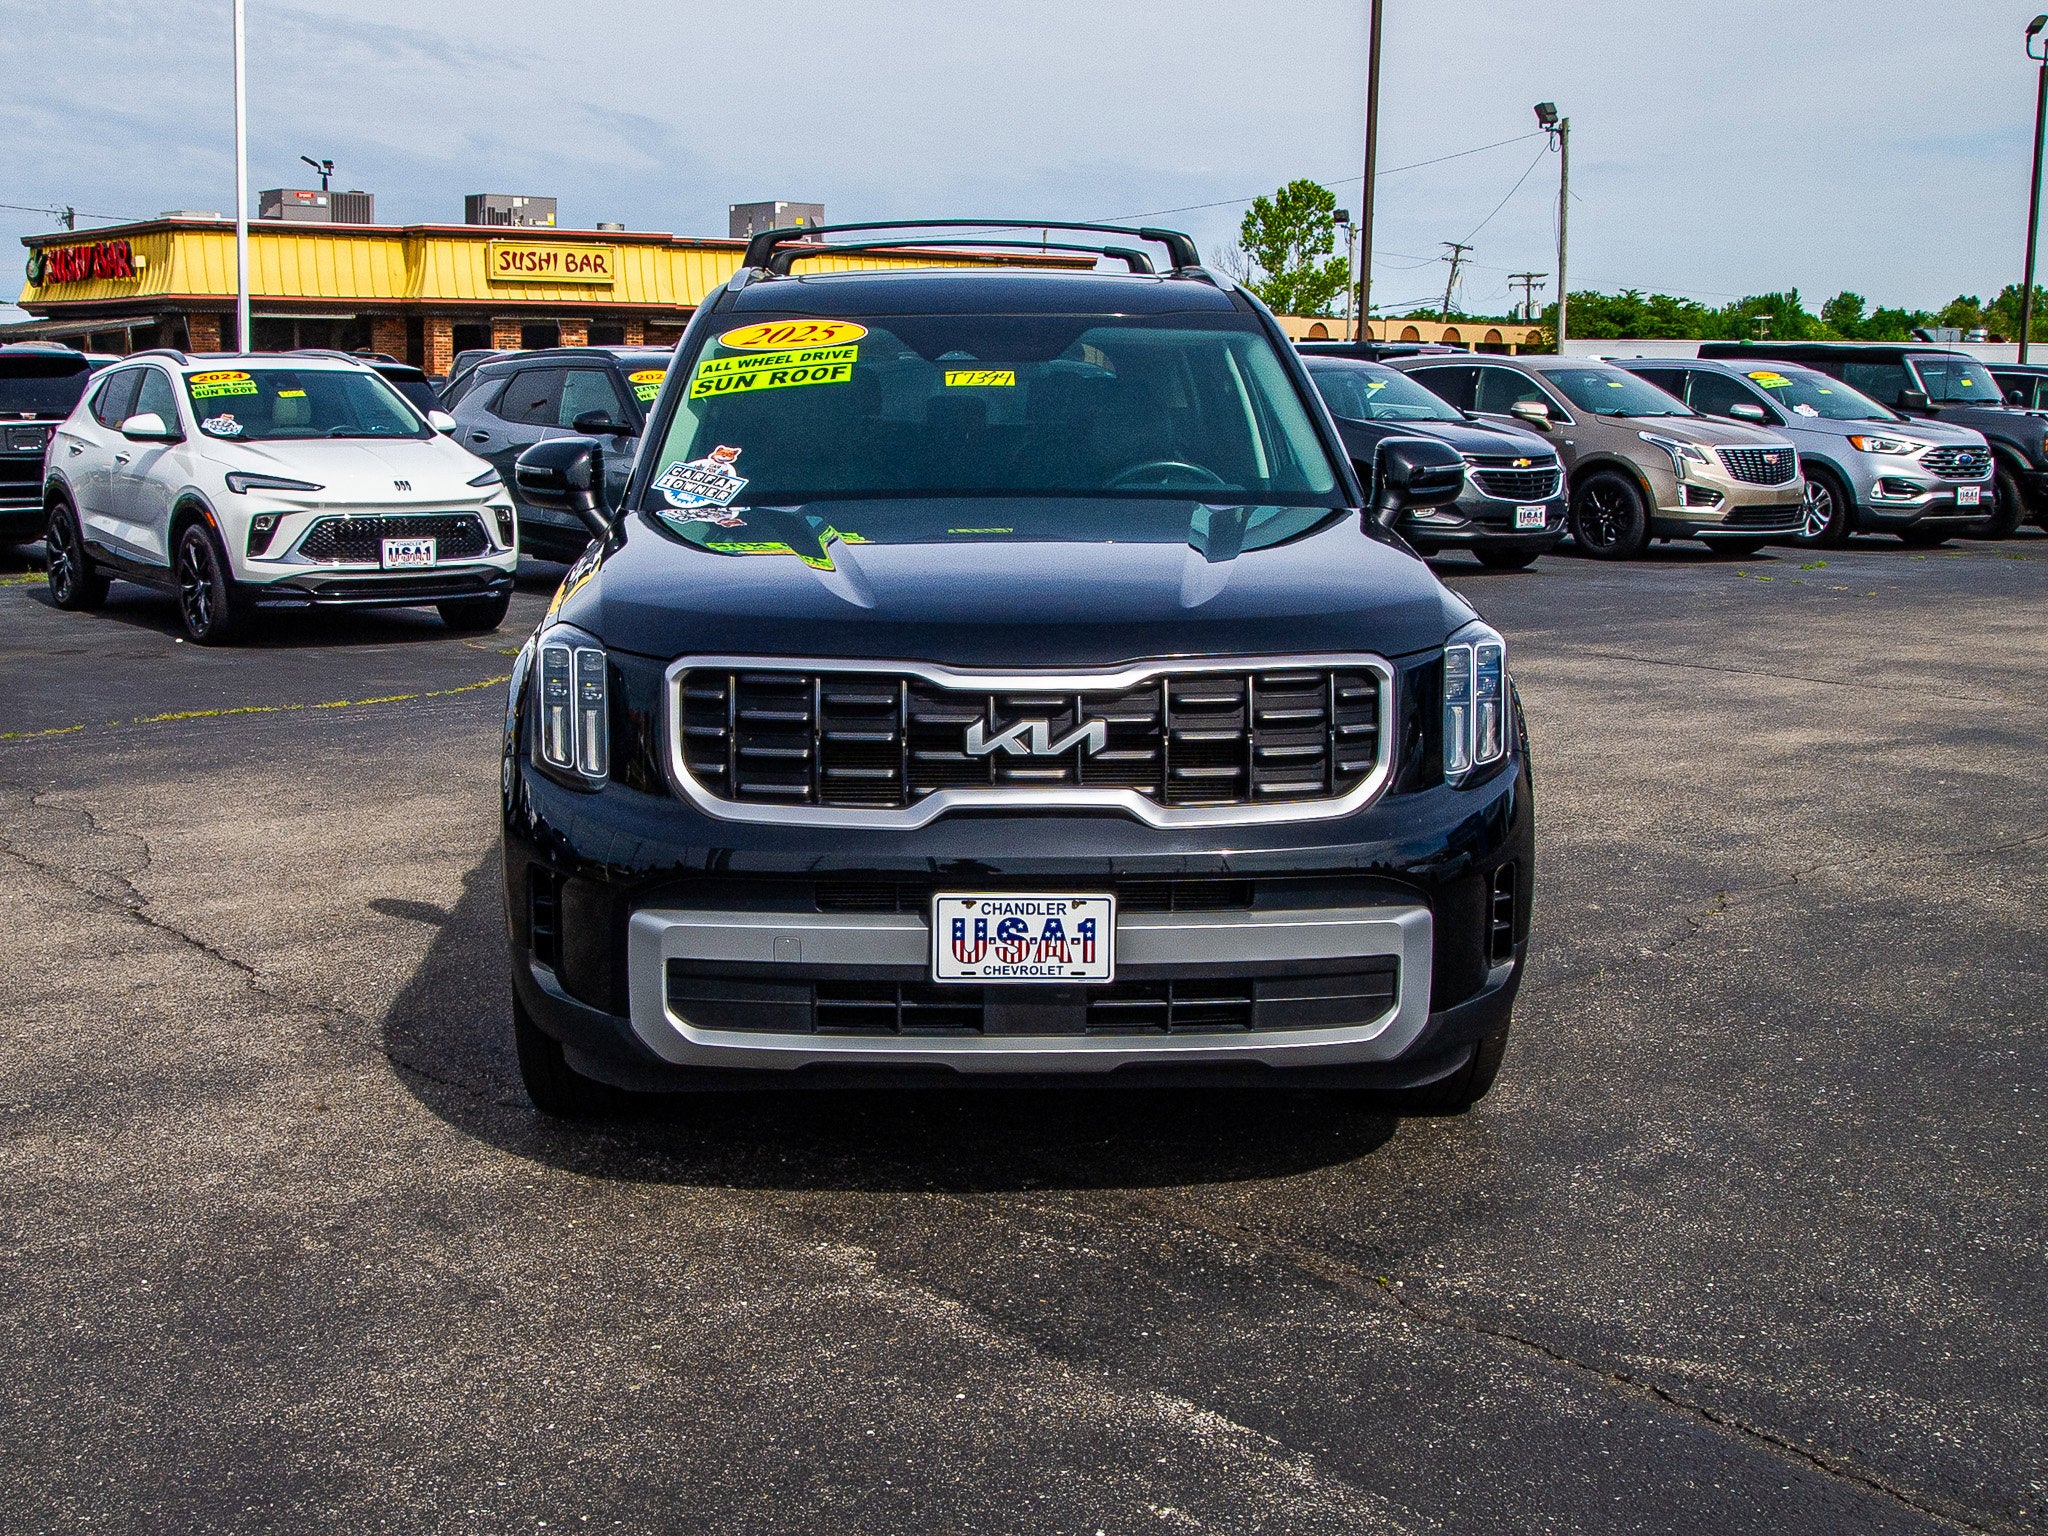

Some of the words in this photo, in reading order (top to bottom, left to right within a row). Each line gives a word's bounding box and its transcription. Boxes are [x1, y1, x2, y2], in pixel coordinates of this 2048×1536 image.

[94, 238, 132, 279] BAR
[500, 251, 557, 271] SUSHI
[566, 253, 608, 273] BAR
[741, 325, 844, 345] 2025
[703, 362, 731, 374] ALL
[737, 354, 793, 369] WHEEL
[800, 350, 854, 362] DRIVE
[198, 373, 243, 382] 2024
[636, 373, 664, 381] 202
[695, 373, 757, 395] SUN
[768, 365, 847, 385] ROOF
[195, 389, 219, 398] SUN
[223, 386, 255, 394] ROOF
[669, 466, 736, 491] CARFAX
[981, 902, 1067, 916] CHANDLER
[983, 965, 1064, 976] CHEVROLET
